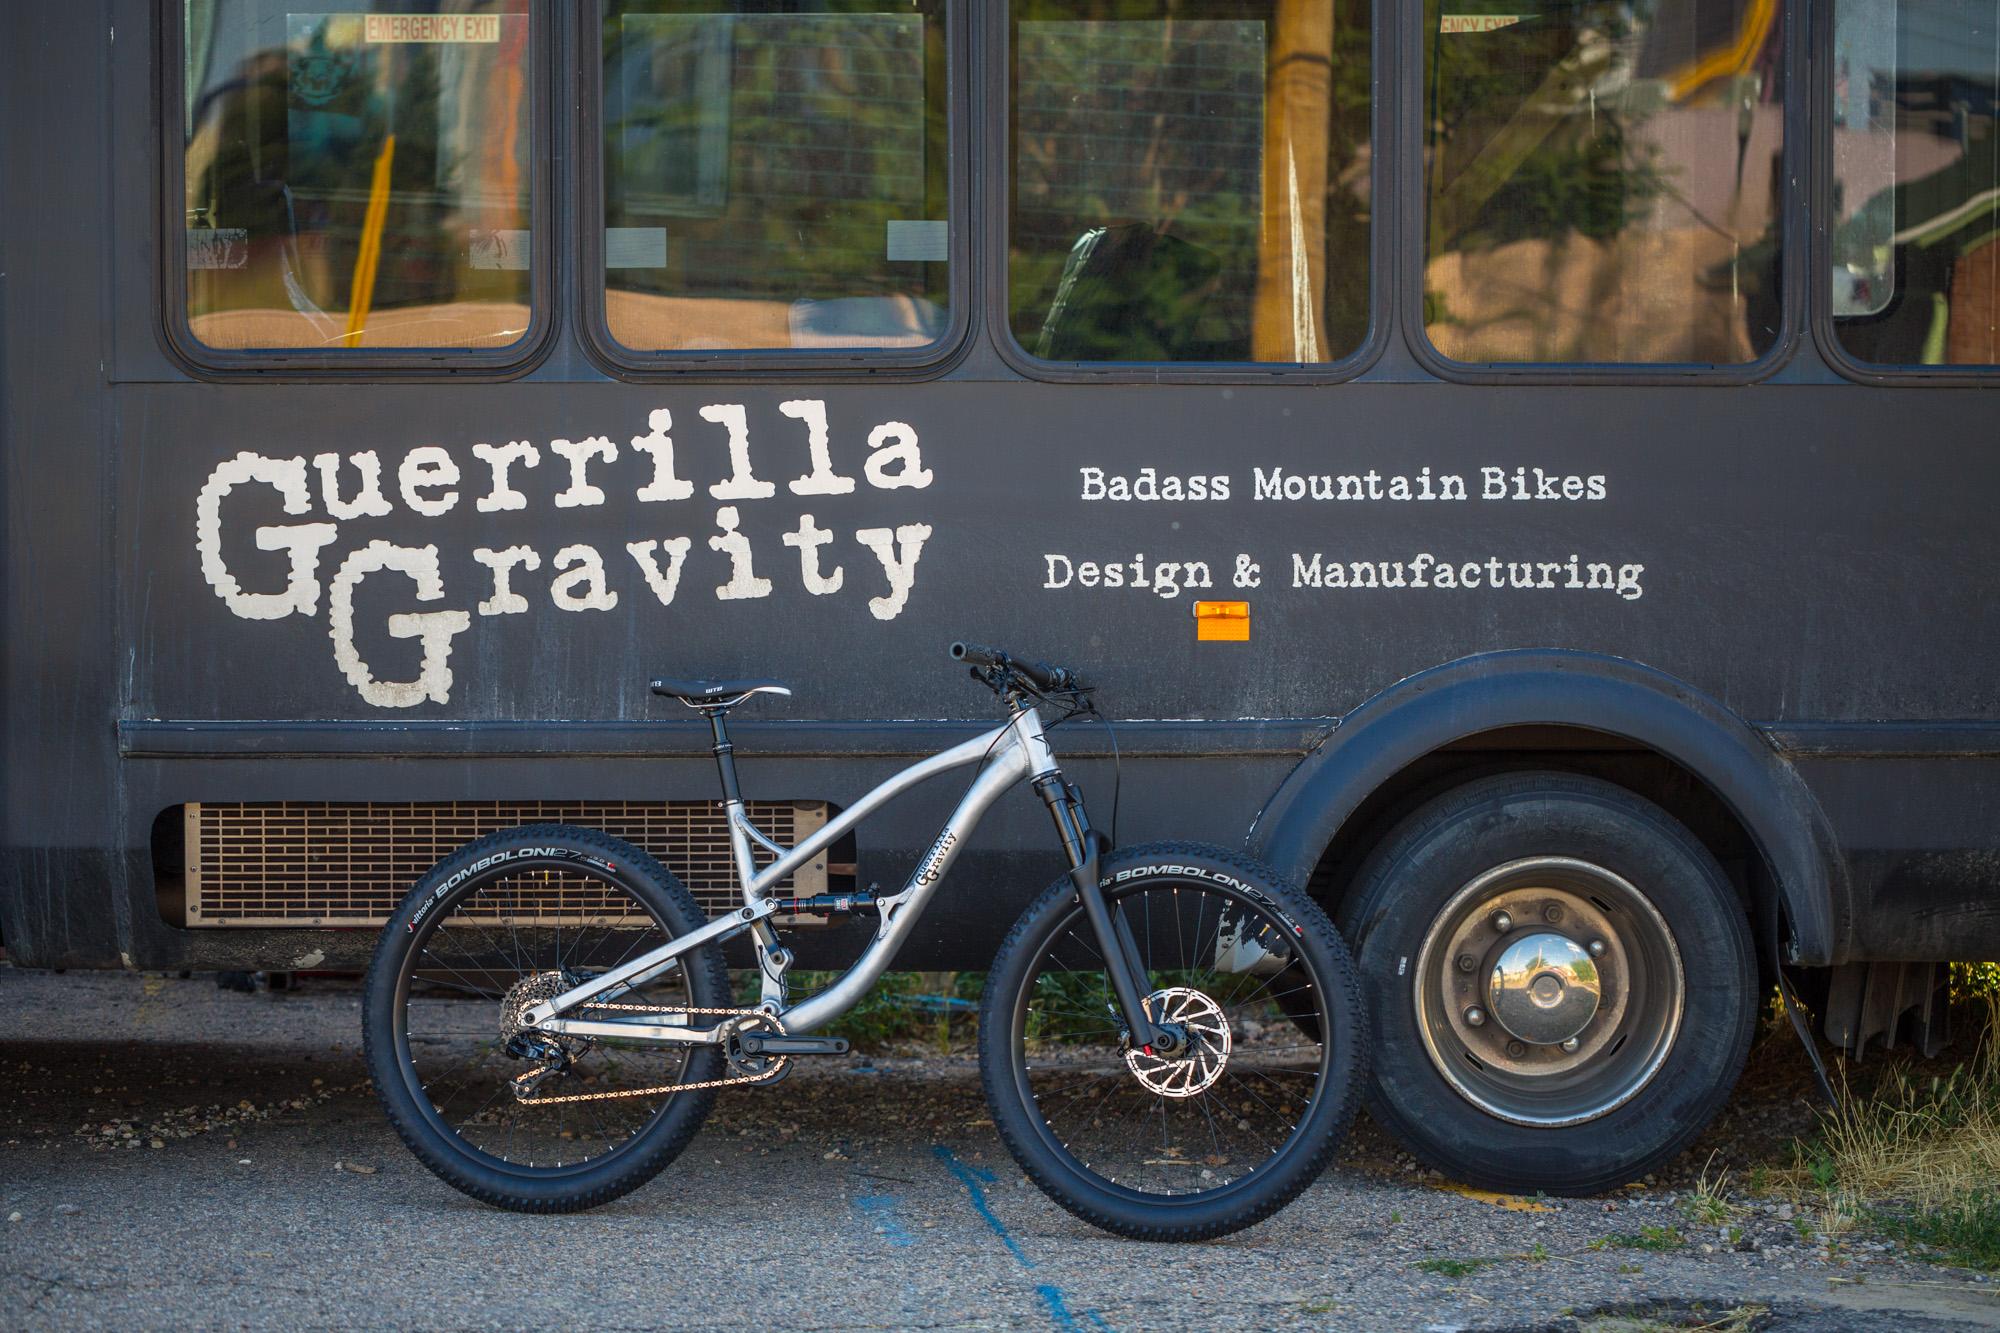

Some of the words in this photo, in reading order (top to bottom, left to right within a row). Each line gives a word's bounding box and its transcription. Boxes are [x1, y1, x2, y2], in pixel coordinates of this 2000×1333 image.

[367, 16, 460, 40] EMERGENCY
[464, 16, 497, 40] EXIT
[1080, 467, 1230, 501] Badass
[1253, 467, 1467, 501] Mountain
[1481, 467, 1606, 501] Bikes
[196, 399, 933, 620] Guerrilla
[1044, 553, 1213, 599] Design
[1233, 554, 1261, 588] &
[1292, 553, 1645, 601] Manufacturing
[329, 506, 932, 707] Gravity
[435, 848, 556, 899] BOMBOLONI
[926, 832, 957, 881] Gravity
[1116, 865, 1252, 895] BOMBOLONI
